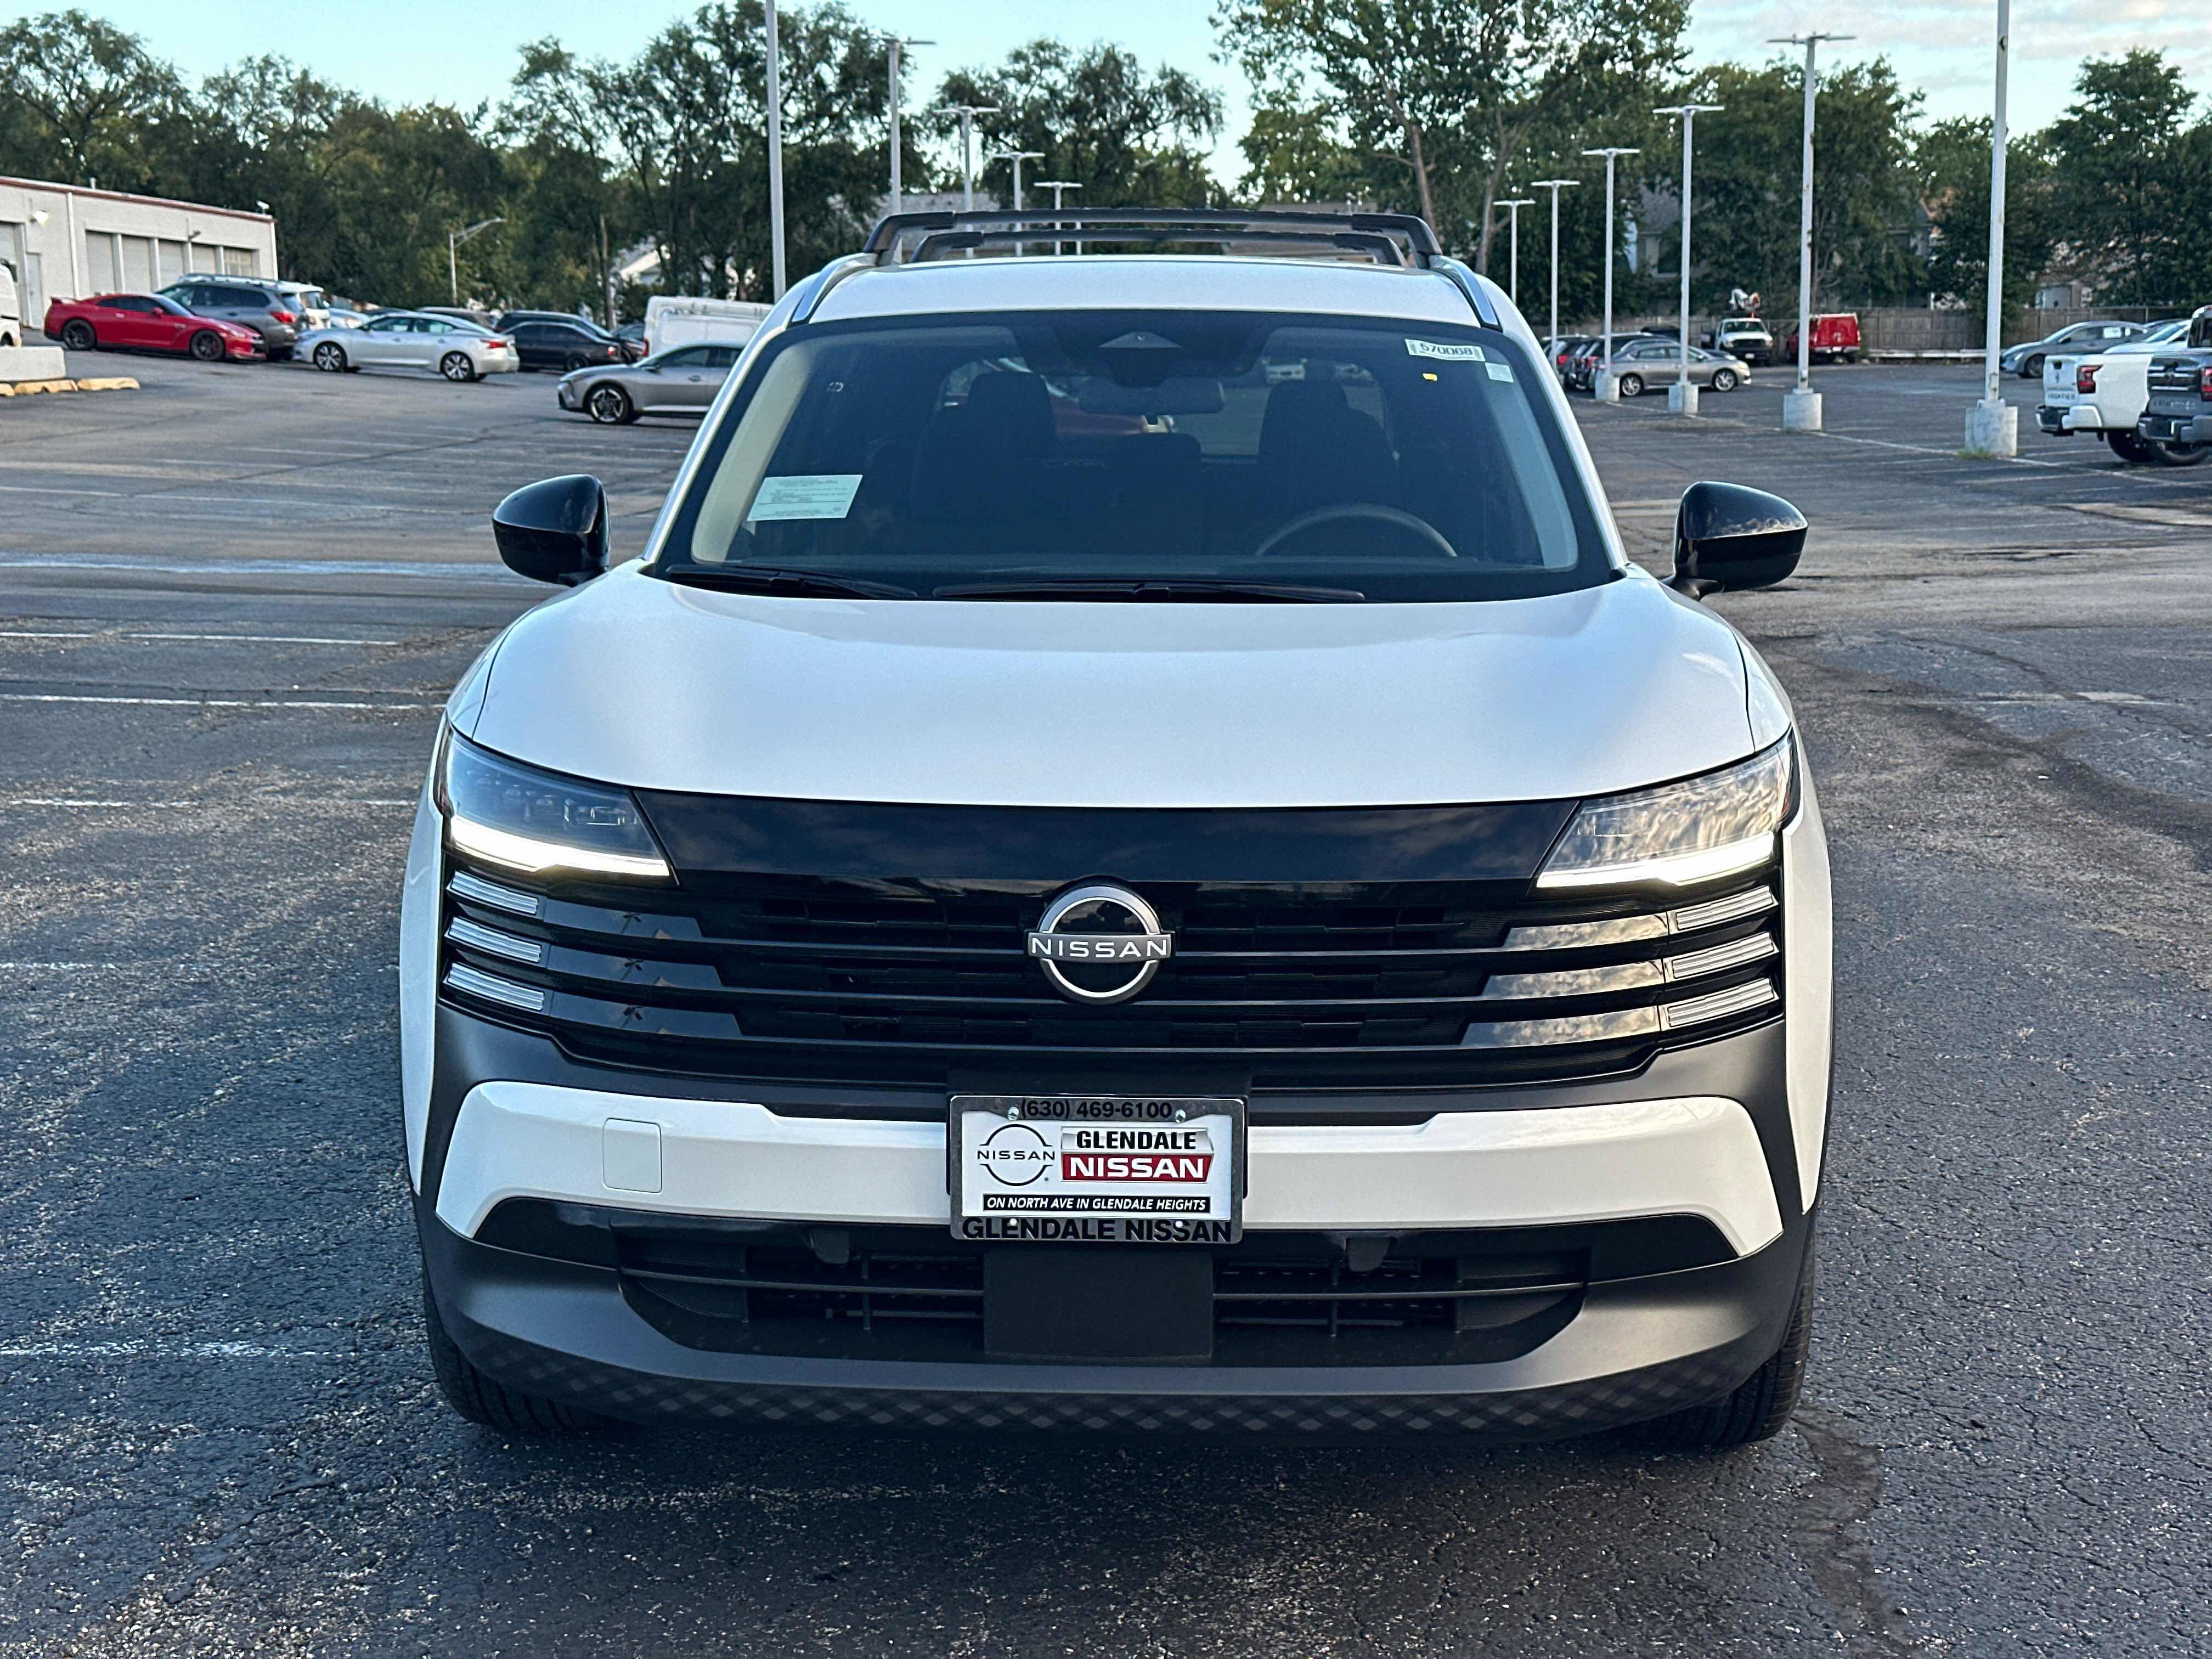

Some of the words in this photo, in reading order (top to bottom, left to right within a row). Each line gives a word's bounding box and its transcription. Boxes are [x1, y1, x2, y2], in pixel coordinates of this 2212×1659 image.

[1420, 342, 1473, 355] 570068
[1031, 937, 1167, 958] NISSAN
[1021, 1099, 1070, 1119] (630)
[1076, 1101, 1172, 1119] 469-6100
[1076, 1130, 1197, 1150] GLENDALE
[977, 1150, 1055, 1160] NISSAN
[1070, 1156, 1204, 1178] NISSAN
[987, 1197, 1005, 1208] ON
[1008, 1197, 1048, 1209] NORTH
[1051, 1198, 1074, 1209] AVE
[1076, 1198, 1090, 1209] IN
[1092, 1198, 1153, 1210] GLENDALE
[1156, 1199, 1206, 1211] HEIGHTS
[962, 1216, 1115, 1240] GLENDALE
[1125, 1219, 1232, 1242] NISSAN
